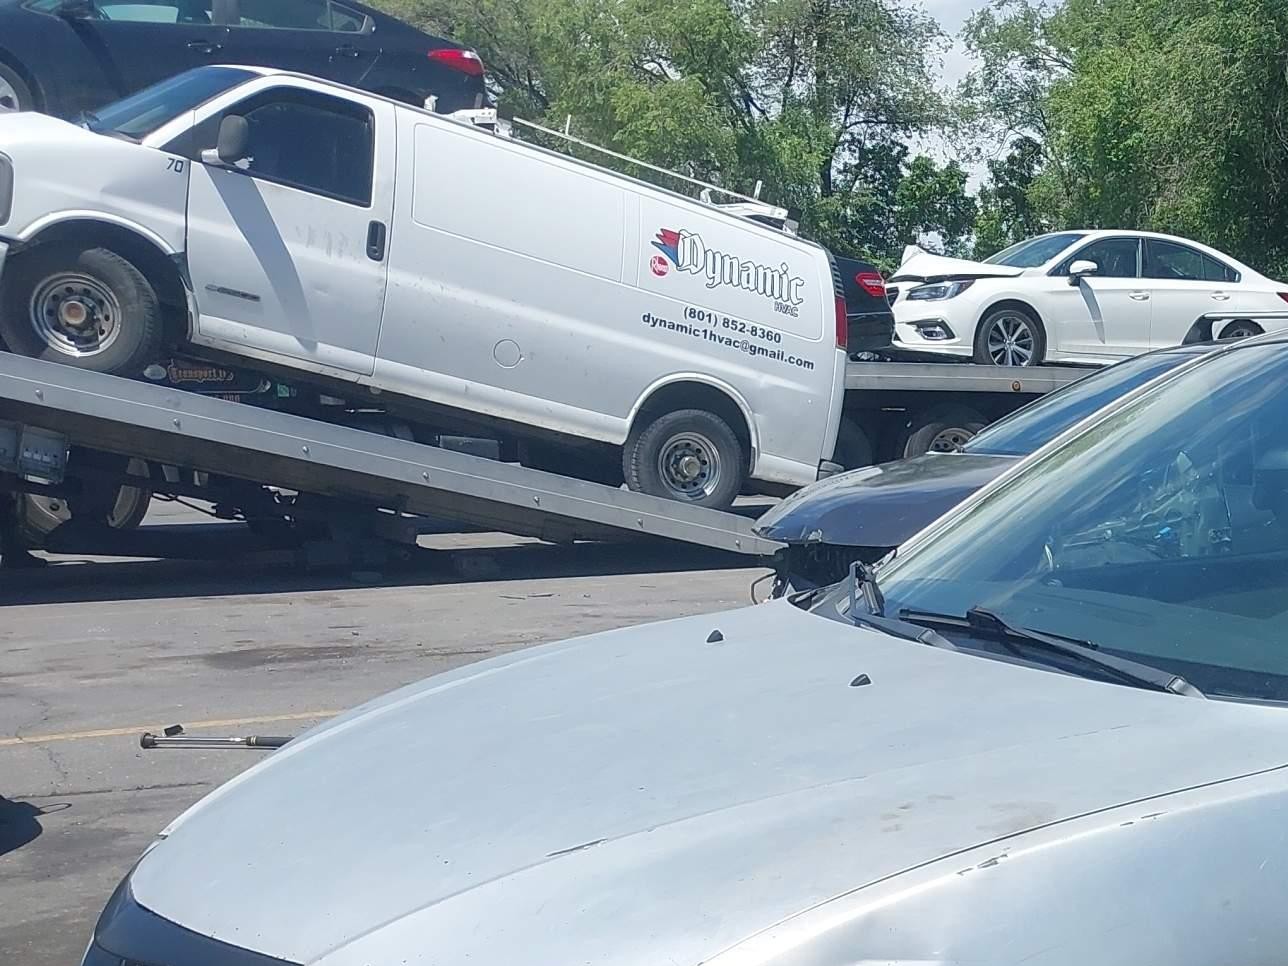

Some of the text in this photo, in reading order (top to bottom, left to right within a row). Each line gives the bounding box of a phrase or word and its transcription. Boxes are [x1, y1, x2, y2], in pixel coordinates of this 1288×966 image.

[166, 158, 184, 173] 70
[676, 229, 804, 305] Dynamic
[684, 306, 782, 344] (801) 852-8360
[773, 301, 799, 318] HVAC
[642, 312, 815, 371] dynamic1hvac@gmail.com
